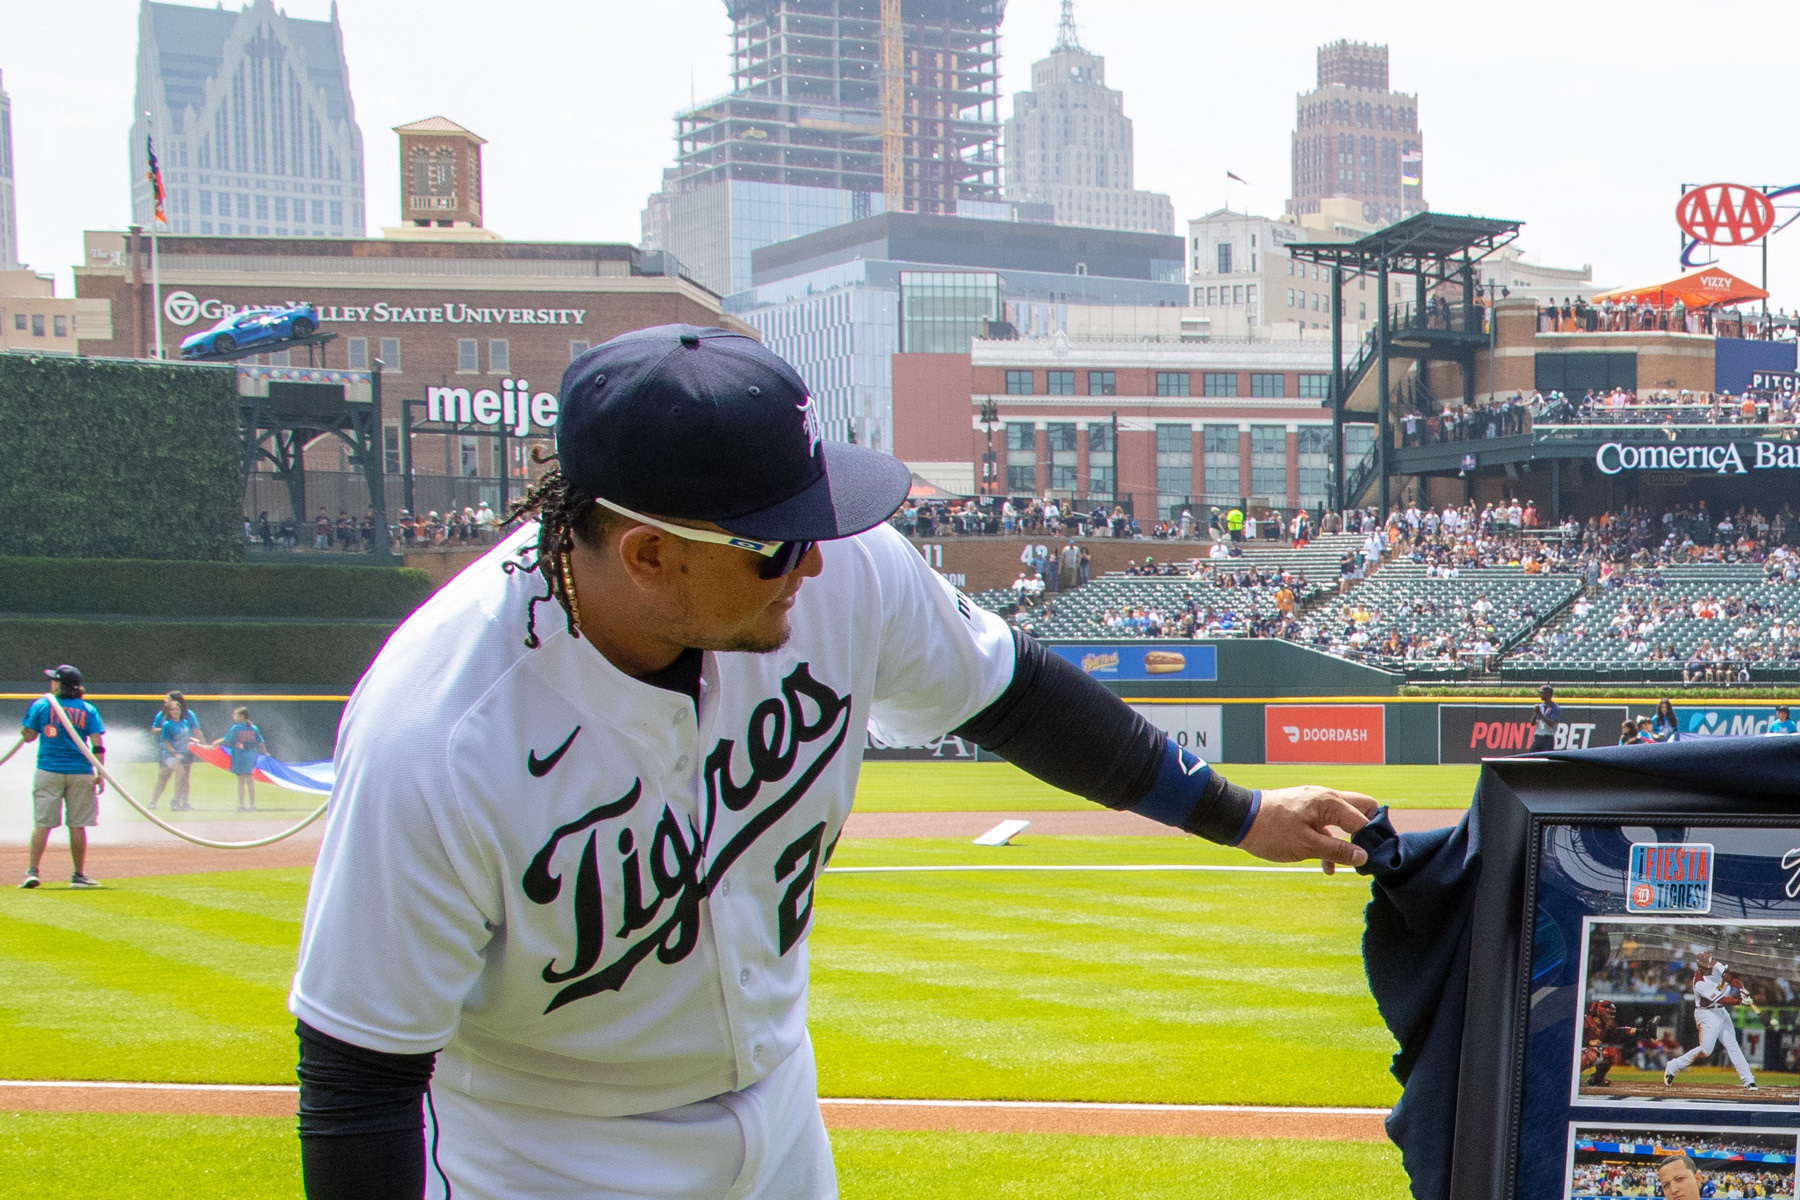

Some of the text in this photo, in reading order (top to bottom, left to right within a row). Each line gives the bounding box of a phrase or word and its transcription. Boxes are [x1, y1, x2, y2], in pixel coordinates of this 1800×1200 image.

[1687, 184, 1768, 244] AAA
[1700, 276, 1732, 289] VIZZY
[374, 303, 444, 322] STATE
[444, 303, 587, 325] UNIVERSITY
[427, 379, 559, 438] meije
[1303, 728, 1368, 743] DOORDASH
[521, 661, 852, 1014] Tigres
